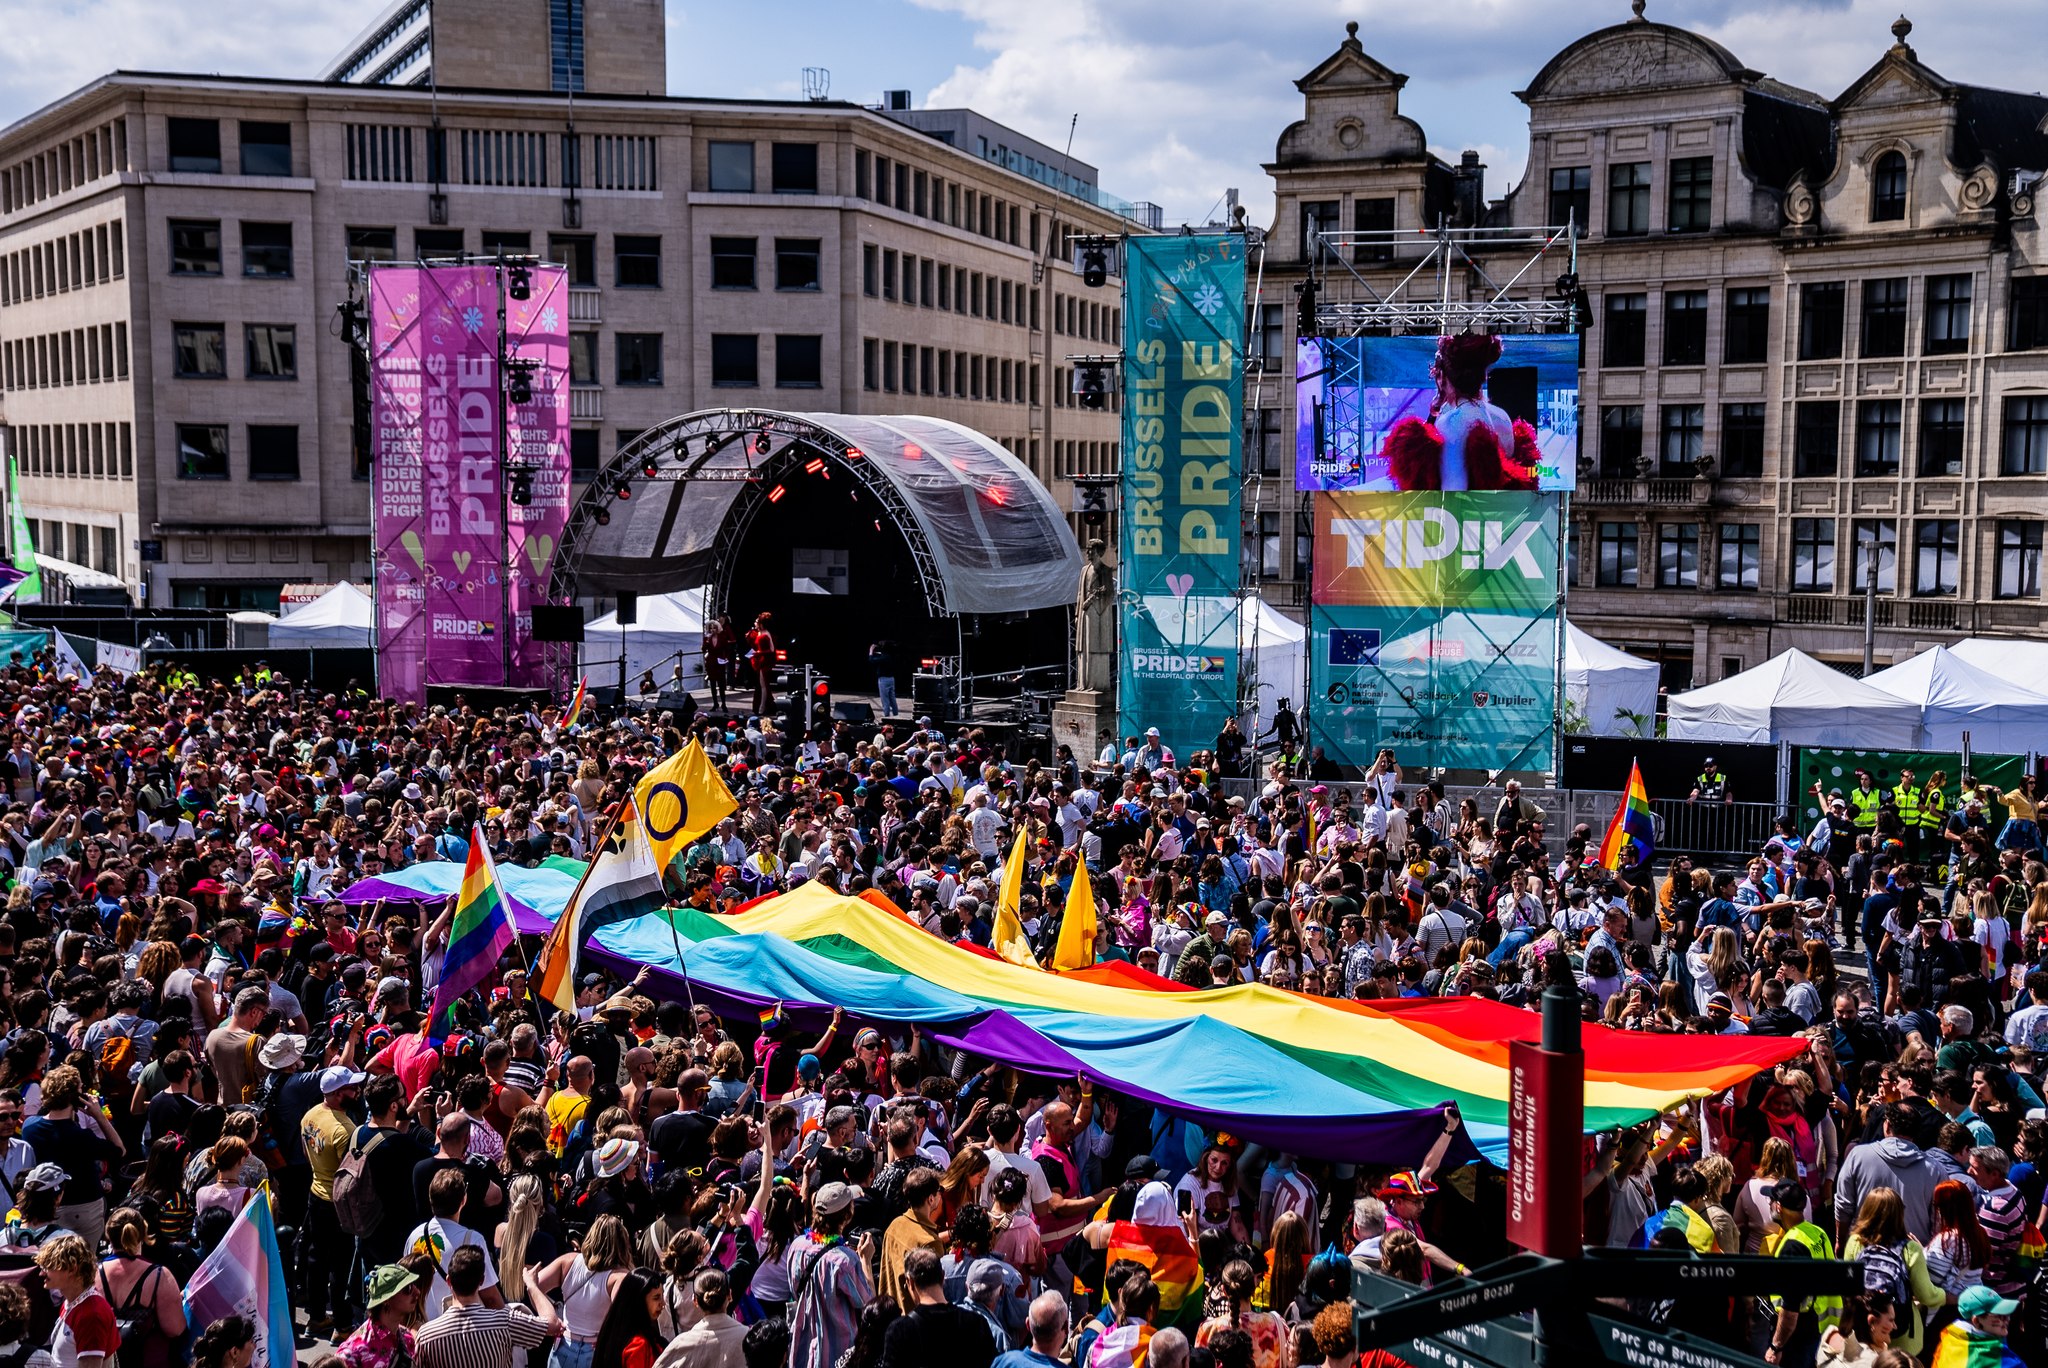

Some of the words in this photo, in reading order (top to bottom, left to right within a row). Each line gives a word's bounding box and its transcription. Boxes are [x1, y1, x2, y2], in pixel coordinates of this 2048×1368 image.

[380, 393, 422, 406] PRO
[510, 411, 538, 426] OUR
[510, 429, 549, 441] RIGHTS
[427, 353, 450, 536] BRUSSELS
[457, 353, 495, 536] PRIDE
[511, 442, 564, 456] FREEDOM
[1134, 339, 1167, 555] BRUSSELS
[1179, 339, 1233, 555] PRIDE
[1310, 463, 1346, 474] PRIDE
[511, 509, 546, 521] FIGHT
[433, 619, 477, 635] PRIDE
[1133, 647, 1169, 655] BRUSSELS
[1432, 649, 1462, 657] HOUSE
[1133, 654, 1200, 673] PRIDE
[1351, 681, 1377, 690] loterie
[1351, 690, 1389, 698] nationale
[1416, 691, 1459, 701] Solidaris
[1490, 694, 1537, 707] Jupiler
[1351, 698, 1376, 708] loterij
[1512, 1128, 1523, 1149] du
[1523, 1095, 1537, 1204] Centrumwijk
[1511, 1154, 1523, 1223] Quartier
[1679, 1265, 1736, 1278] Casino
[1483, 1282, 1515, 1300] Bozar
[1611, 1327, 1641, 1348] Parc
[1648, 1339, 1665, 1355] de
[1413, 1337, 1441, 1360] César
[1445, 1352, 1458, 1368] de
[1625, 1347, 1686, 1368] Warand
